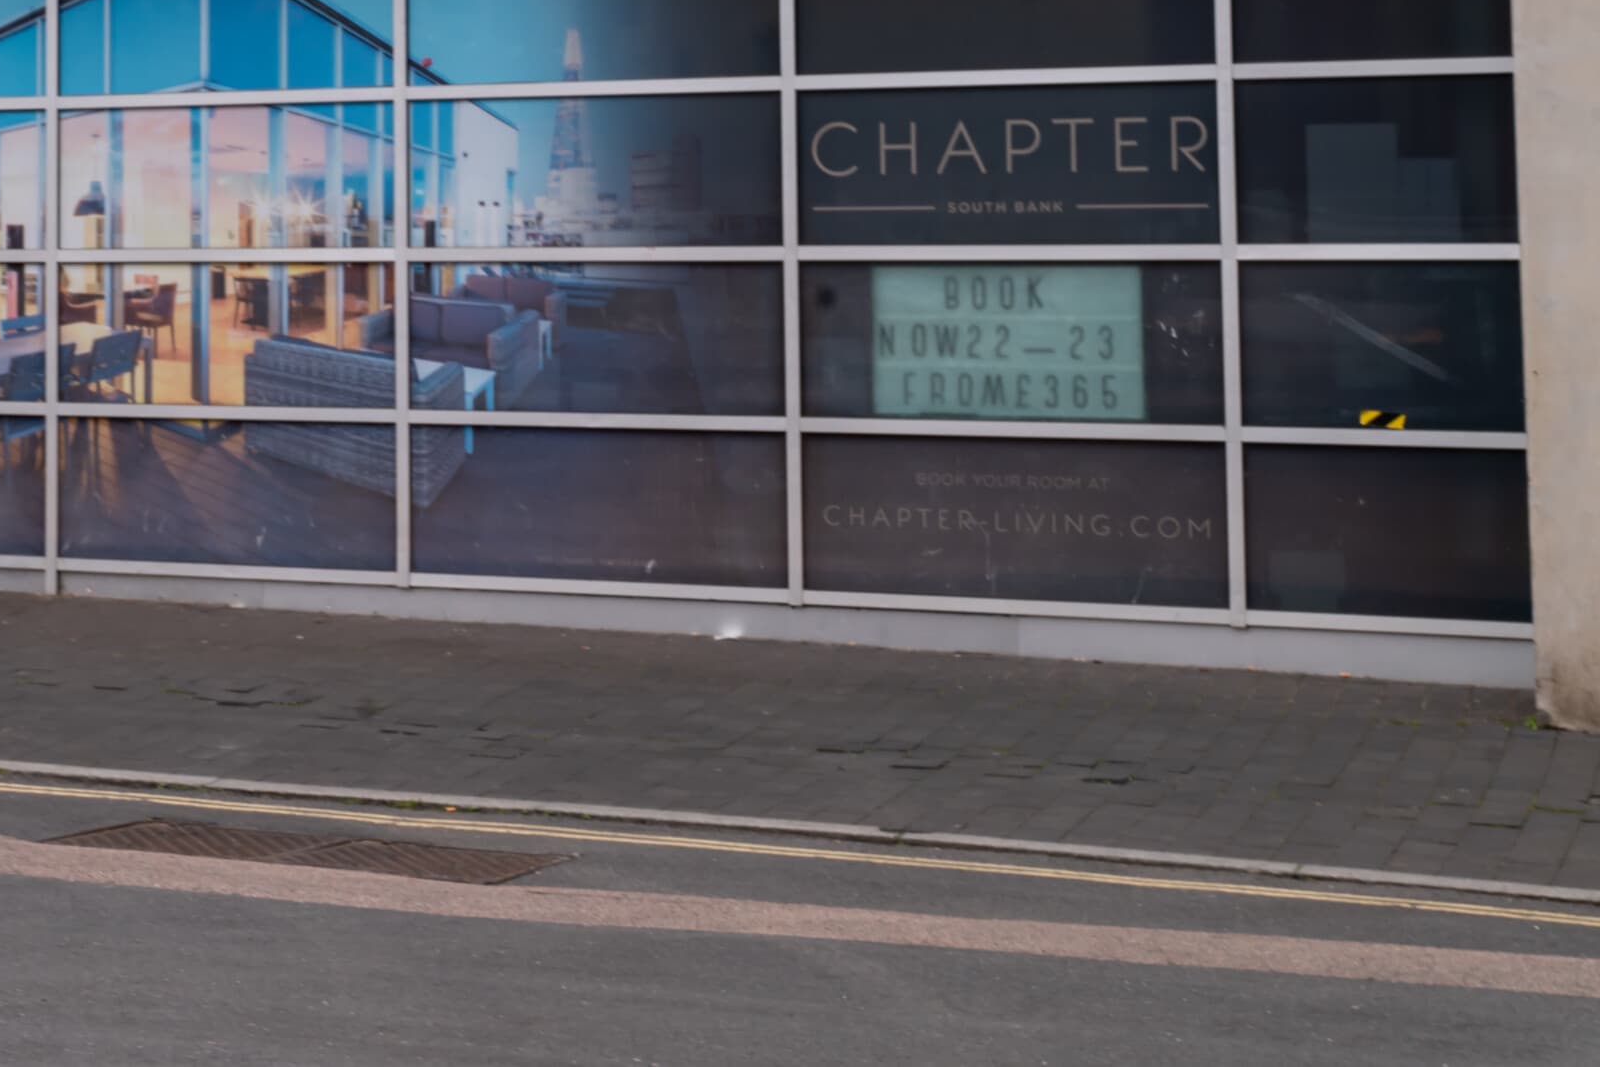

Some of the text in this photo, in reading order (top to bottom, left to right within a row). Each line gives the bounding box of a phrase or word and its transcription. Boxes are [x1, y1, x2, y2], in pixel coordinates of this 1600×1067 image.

[810, 116, 1209, 178] CHAPTER
[947, 200, 1064, 215] SOUTH BANK
[943, 275, 1045, 311] BOOK
[914, 471, 1111, 491] BOOK YOUR ROOM AT
